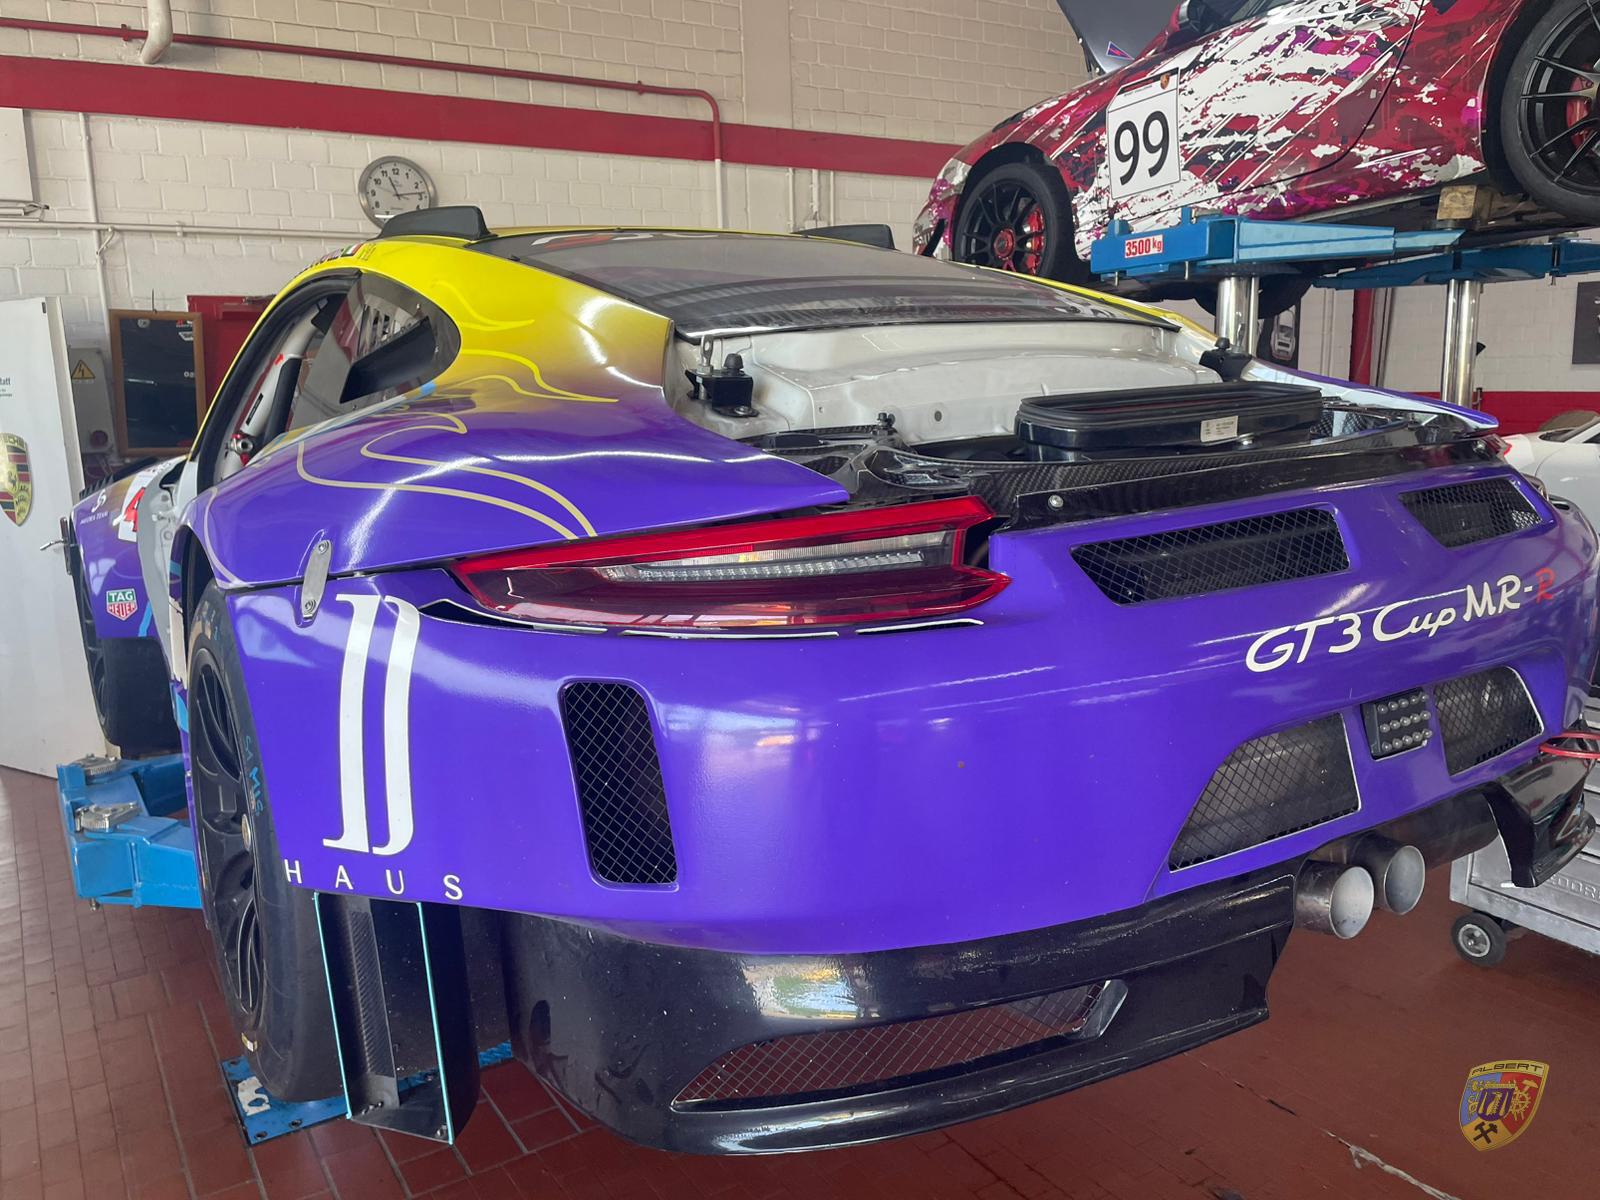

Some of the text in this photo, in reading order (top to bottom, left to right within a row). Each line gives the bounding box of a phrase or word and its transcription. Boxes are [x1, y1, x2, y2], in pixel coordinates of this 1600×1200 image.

[1114, 110, 1170, 186] 99
[381, 170, 388, 178] 11
[392, 168, 400, 176] 12
[1126, 237, 1162, 257] 3500 kg
[109, 591, 134, 602] TAG
[108, 602, 136, 618] HEUER
[1372, 600, 1456, 642] Cup
[283, 858, 464, 901] HAUS
